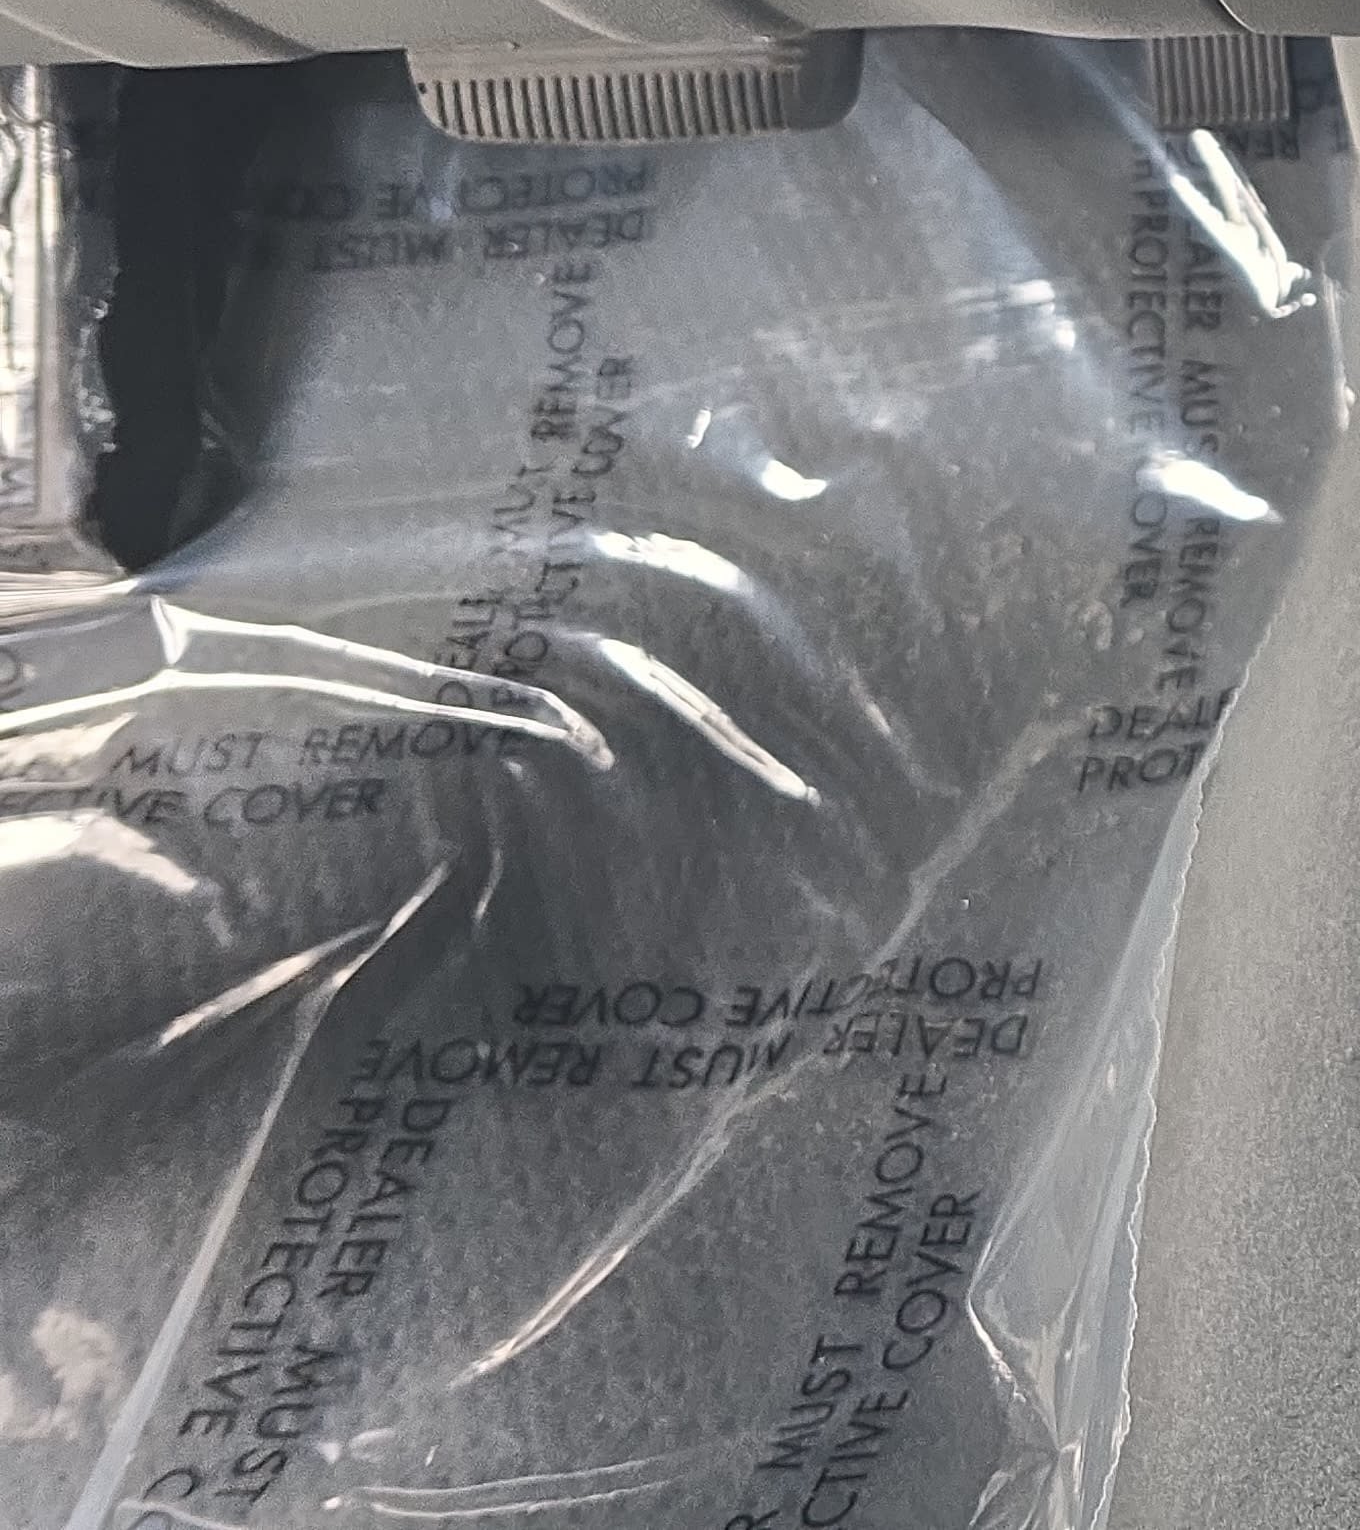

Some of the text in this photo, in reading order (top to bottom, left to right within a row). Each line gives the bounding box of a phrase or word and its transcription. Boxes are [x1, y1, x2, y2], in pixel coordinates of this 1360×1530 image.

[375, 159, 653, 222] PROTECVE
[529, 261, 596, 443] REMOVE
[1126, 189, 1171, 435] PROTECTIVE
[568, 354, 638, 480] COVER
[1179, 358, 1222, 458] MUS
[1120, 480, 1170, 609] OVER
[1154, 517, 1222, 693] REMOVE
[112, 730, 266, 778] MUST
[204, 778, 386, 829] COVER
[352, 1014, 1029, 1090] DEALER MUST REMOVE
[511, 956, 1043, 1028] PROTECTIVE COVER
[177, 1093, 388, 1438] PROTECTIVE
[213, 1097, 454, 1503] DEALER MUST
[755, 1072, 948, 1473] MUST REMOVE
[881, 1189, 981, 1371] COVER
